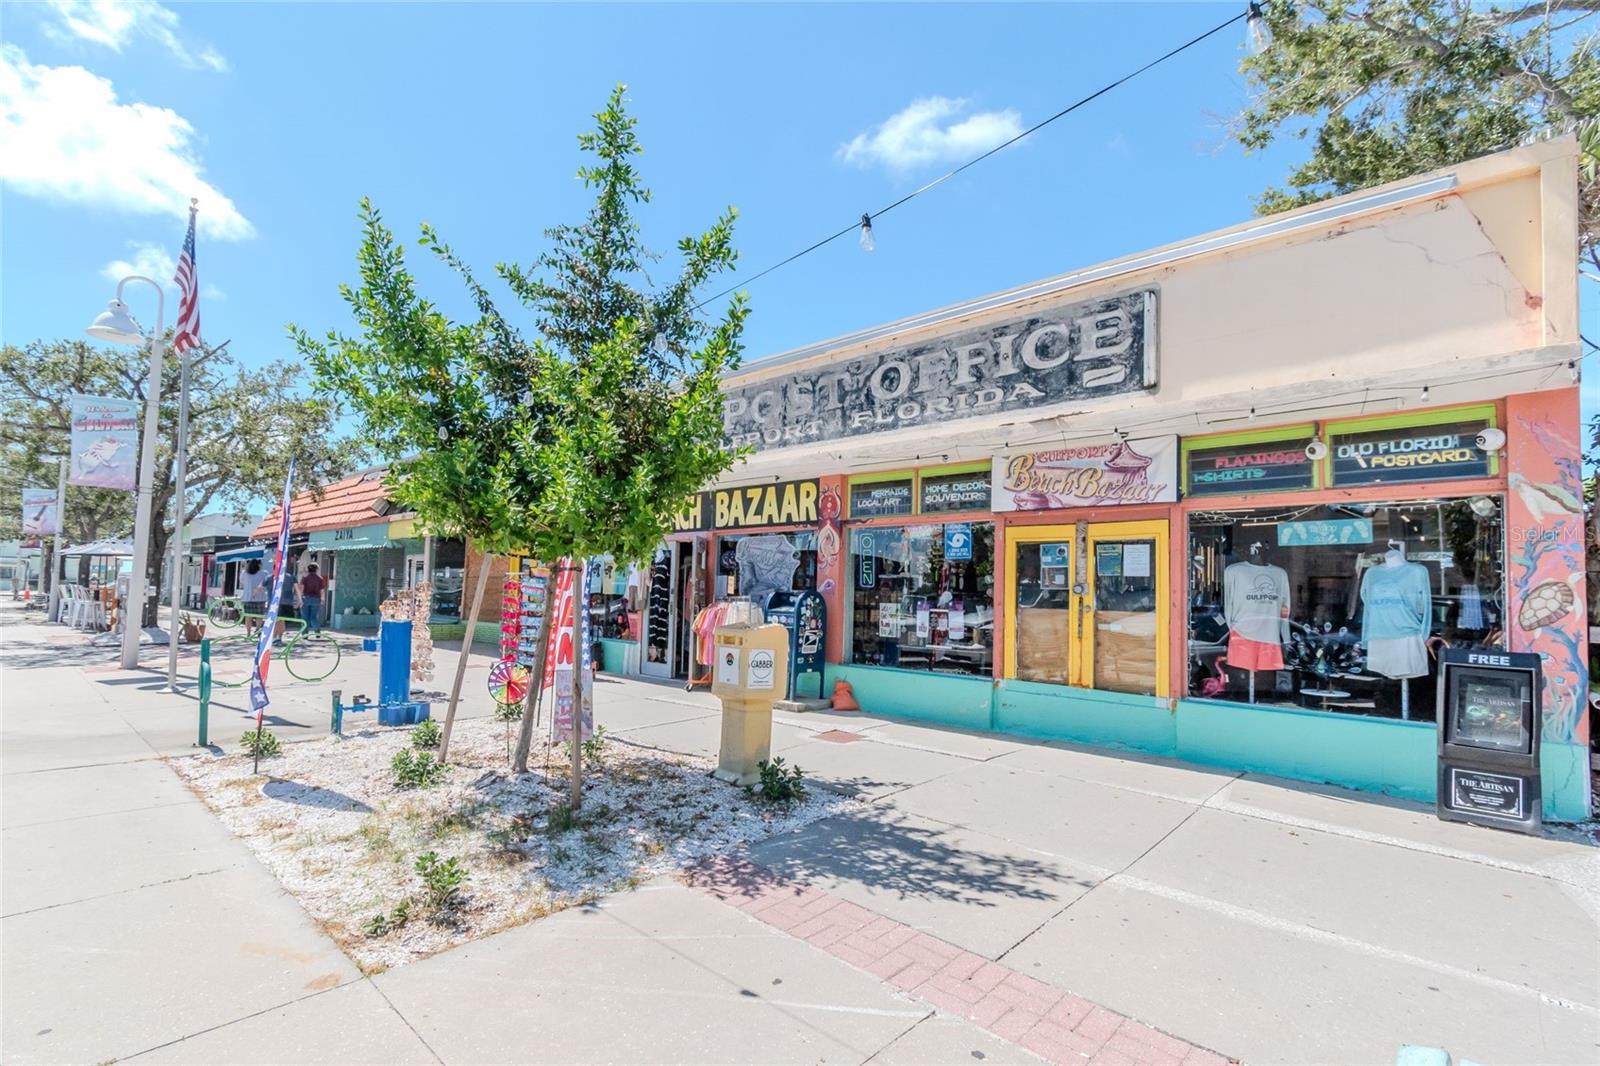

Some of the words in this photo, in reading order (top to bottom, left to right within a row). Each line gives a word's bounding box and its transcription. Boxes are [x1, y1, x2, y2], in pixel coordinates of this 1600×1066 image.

[724, 374, 848, 436] POST
[870, 309, 1135, 400] OFFICE
[719, 420, 824, 450] LFPORT
[851, 382, 1046, 428] FLORIDA
[1337, 442, 1374, 458] OLD
[1379, 434, 1459, 454] FLORIDA
[1215, 451, 1307, 469] FLAMINGOS
[1003, 452, 1074, 495] Beach
[1075, 466, 1168, 501] Bazaar
[925, 484, 949, 494] HOME
[952, 480, 986, 491] DECOR
[671, 495, 702, 530] ACH
[715, 481, 818, 528] BAZAAR
[857, 498, 881, 508] LOCAL
[883, 497, 902, 507] ART
[925, 492, 987, 504] SOUVENIRS
[334, 530, 353, 541] ZAIYA
[861, 536, 873, 585] OPEN
[751, 660, 774, 669] GABBER
[1468, 654, 1511, 666] FREE
[1460, 777, 1478, 787] THE
[1479, 781, 1515, 793] ARTISAN
